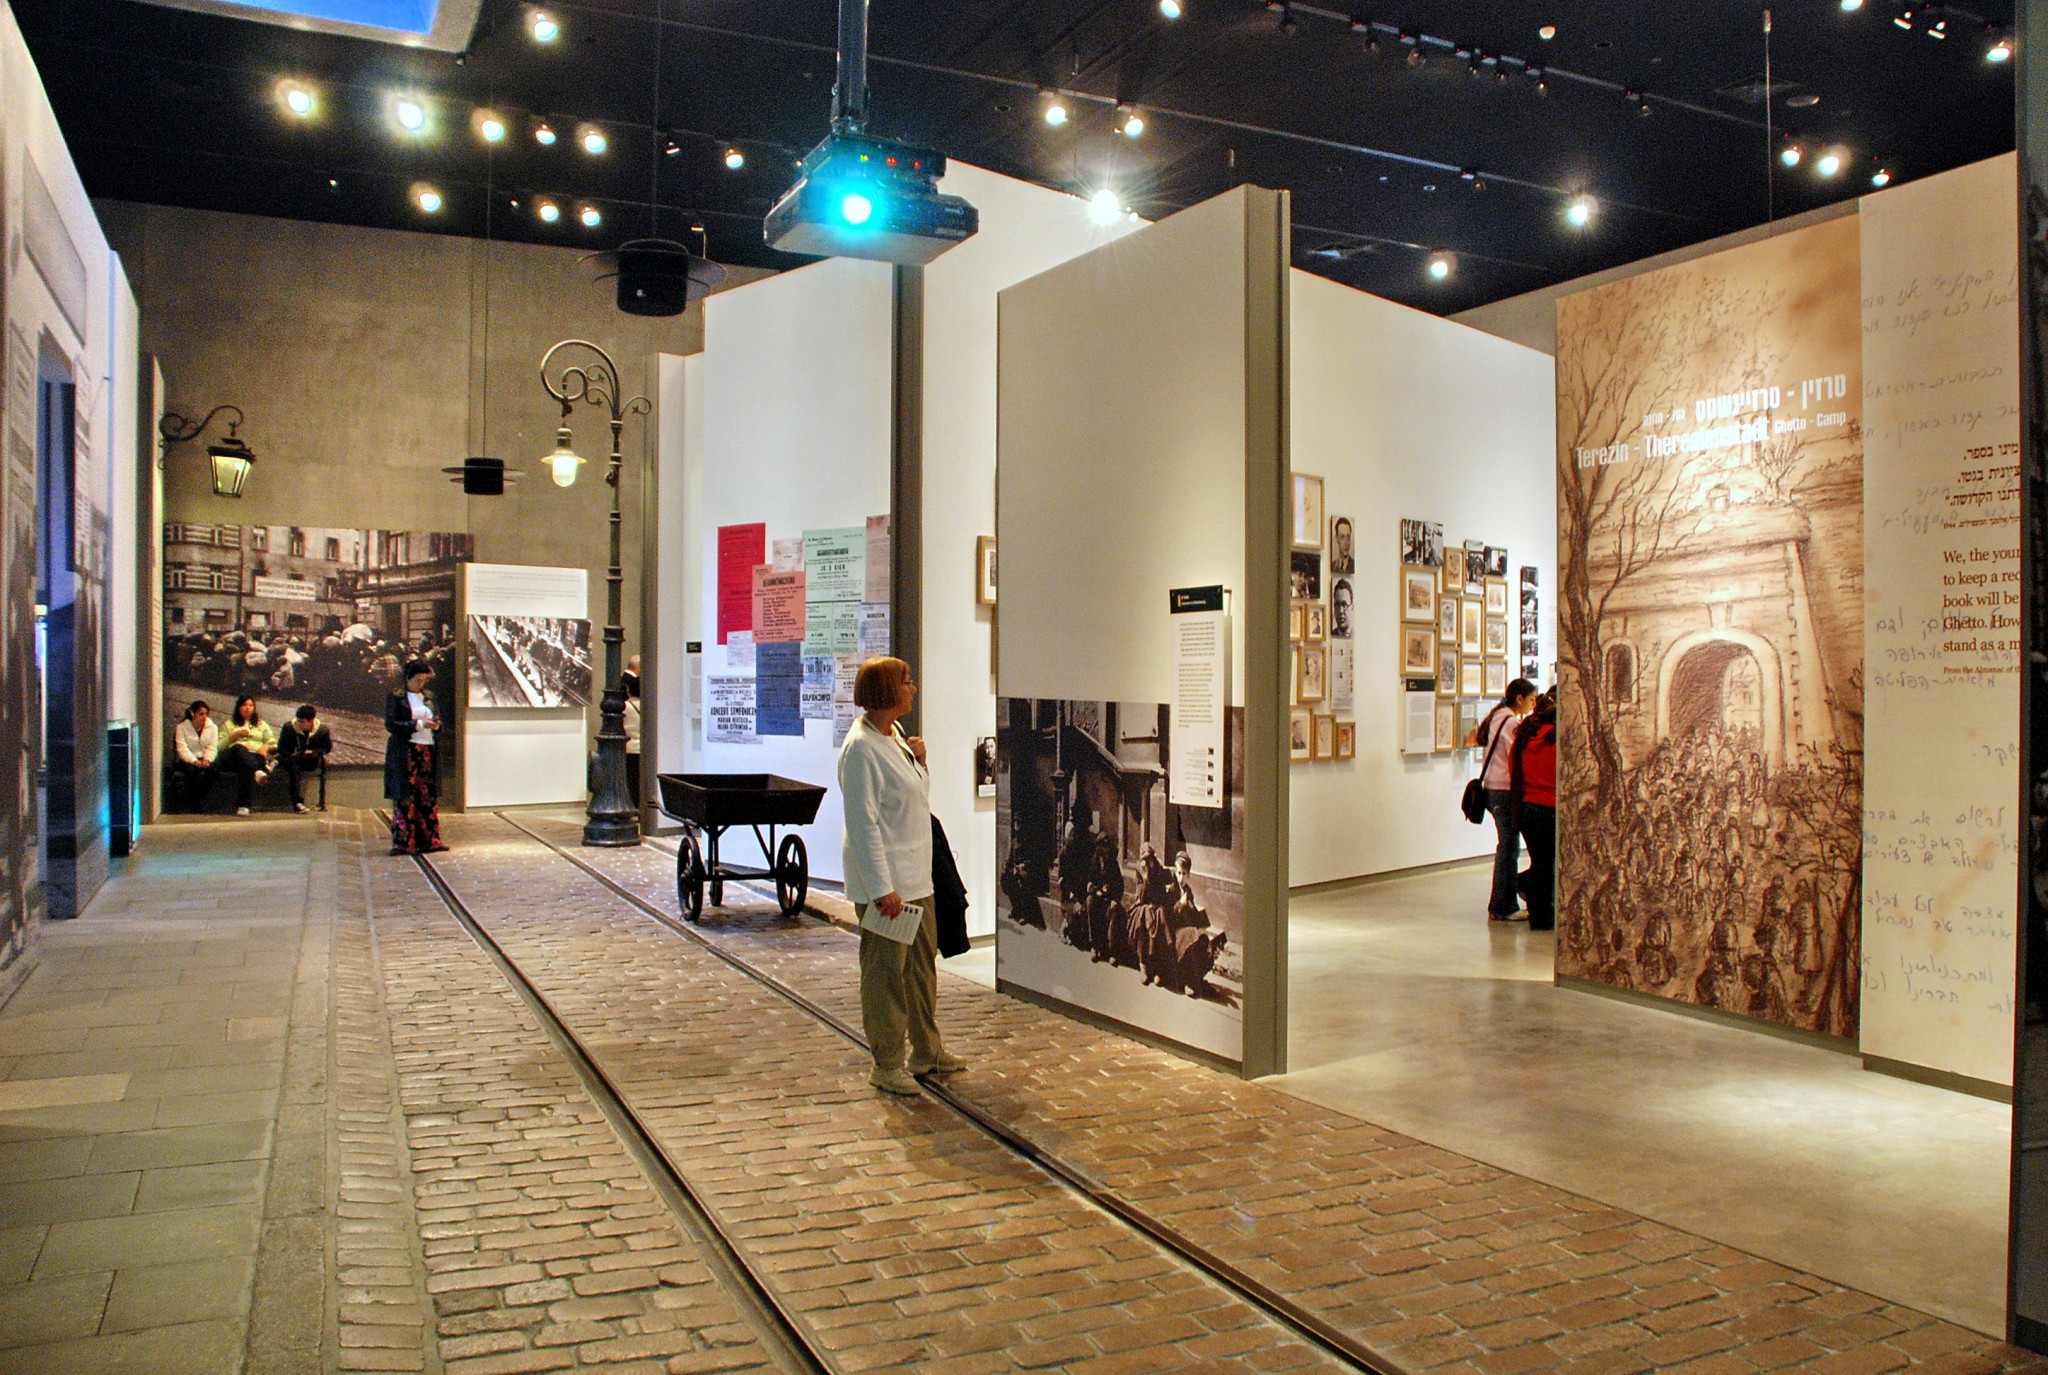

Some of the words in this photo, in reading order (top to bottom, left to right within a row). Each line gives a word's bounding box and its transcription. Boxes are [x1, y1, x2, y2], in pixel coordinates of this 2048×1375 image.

[1802, 374, 1846, 410] טרזין
[1577, 441, 1629, 469] Terezin
[1644, 417, 1769, 458] Theresienstadt
[1775, 417, 1806, 434] Ghetto
[1817, 410, 1846, 430] Camp
[1943, 550, 1966, 564] We,
[1970, 548, 1989, 562] the
[1943, 574, 1956, 586] to
[1958, 571, 1987, 587] keep
[1990, 572, 1998, 582] a
[1943, 593, 1973, 608] book
[1976, 592, 2000, 605] will
[2003, 591, 2019, 605] be
[1943, 616, 1988, 630] Ghetto.
[1943, 638, 1977, 652] stand
[1980, 641, 1994, 651] as
[1997, 641, 2005, 651] a
